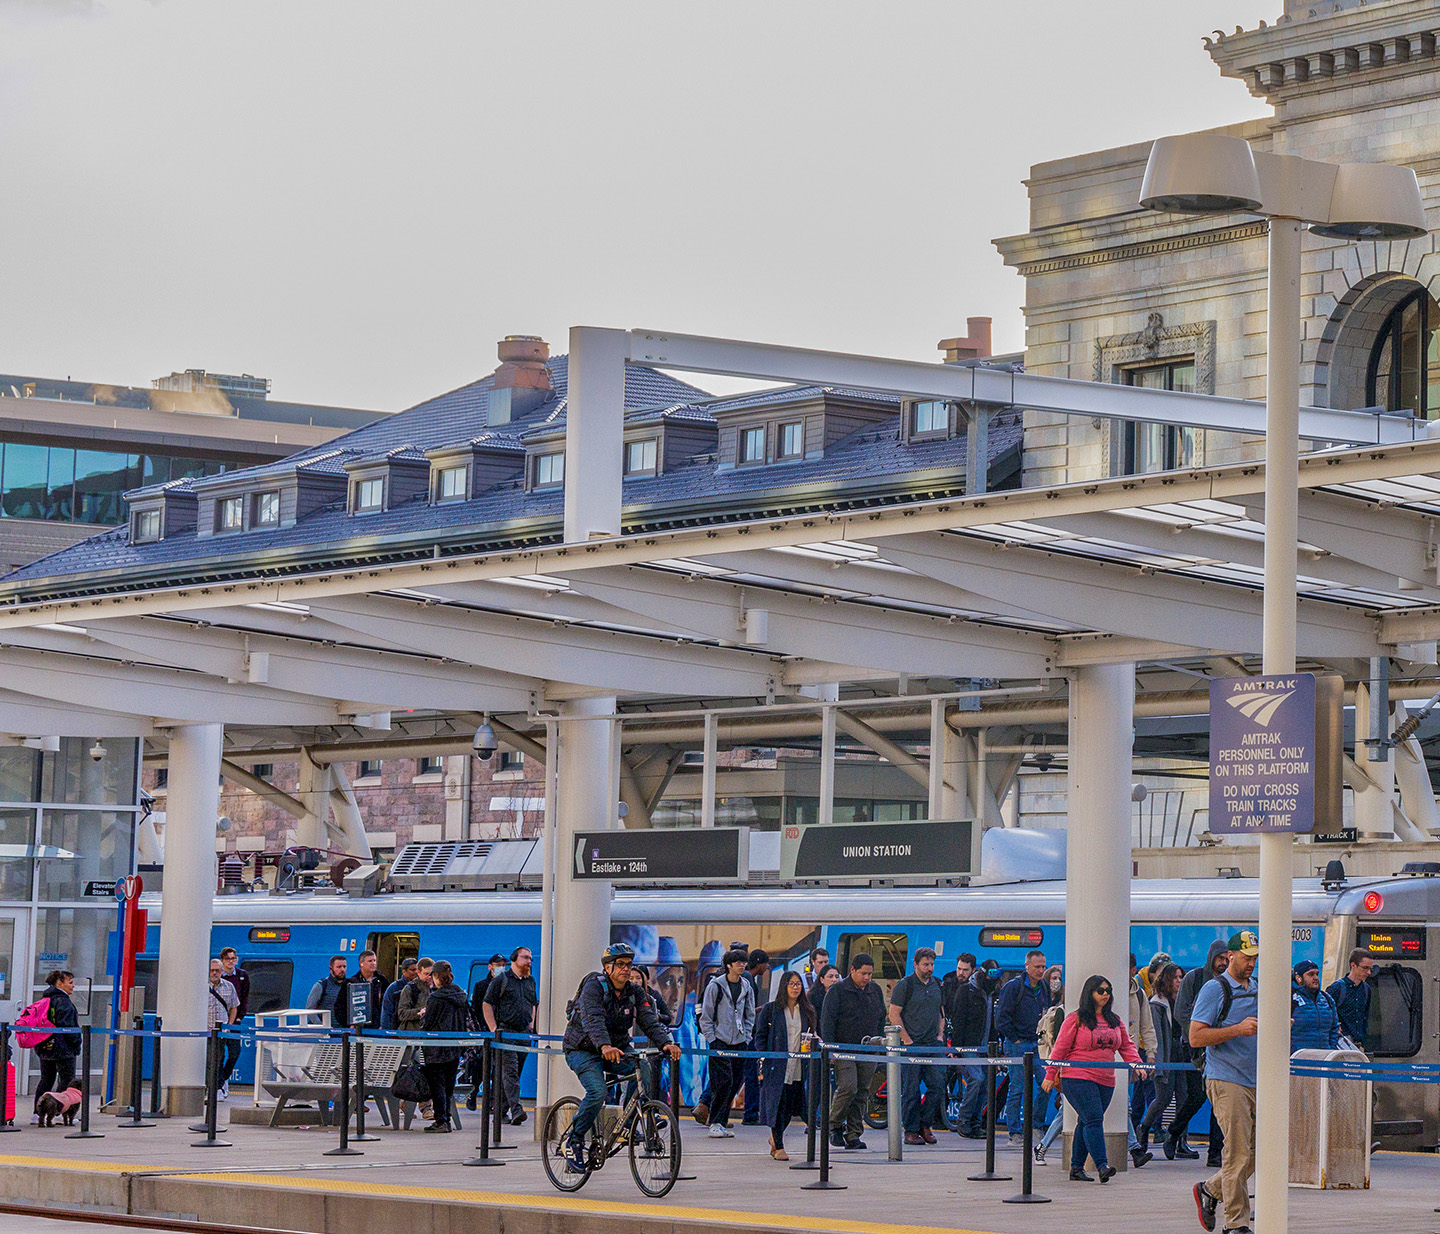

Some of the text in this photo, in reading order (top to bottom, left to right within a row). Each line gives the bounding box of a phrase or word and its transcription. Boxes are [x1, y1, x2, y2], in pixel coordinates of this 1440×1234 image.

[1233, 679, 1296, 692] AMTRAK
[1241, 732, 1282, 746] AMTRAK
[1219, 747, 1305, 761] PERSONNEL ONLY
[1215, 762, 1309, 777] ON THIS PLATFORM
[1223, 783, 1299, 797] DO NOT CROSS
[1226, 799, 1297, 812] TRAIN TRACKS
[1230, 814, 1292, 827] AT ANY TIME
[1350, 830, 1355, 840] 1
[842, 844, 912, 858] UNION STATION
[592, 861, 648, 873] Eastlake 124th
